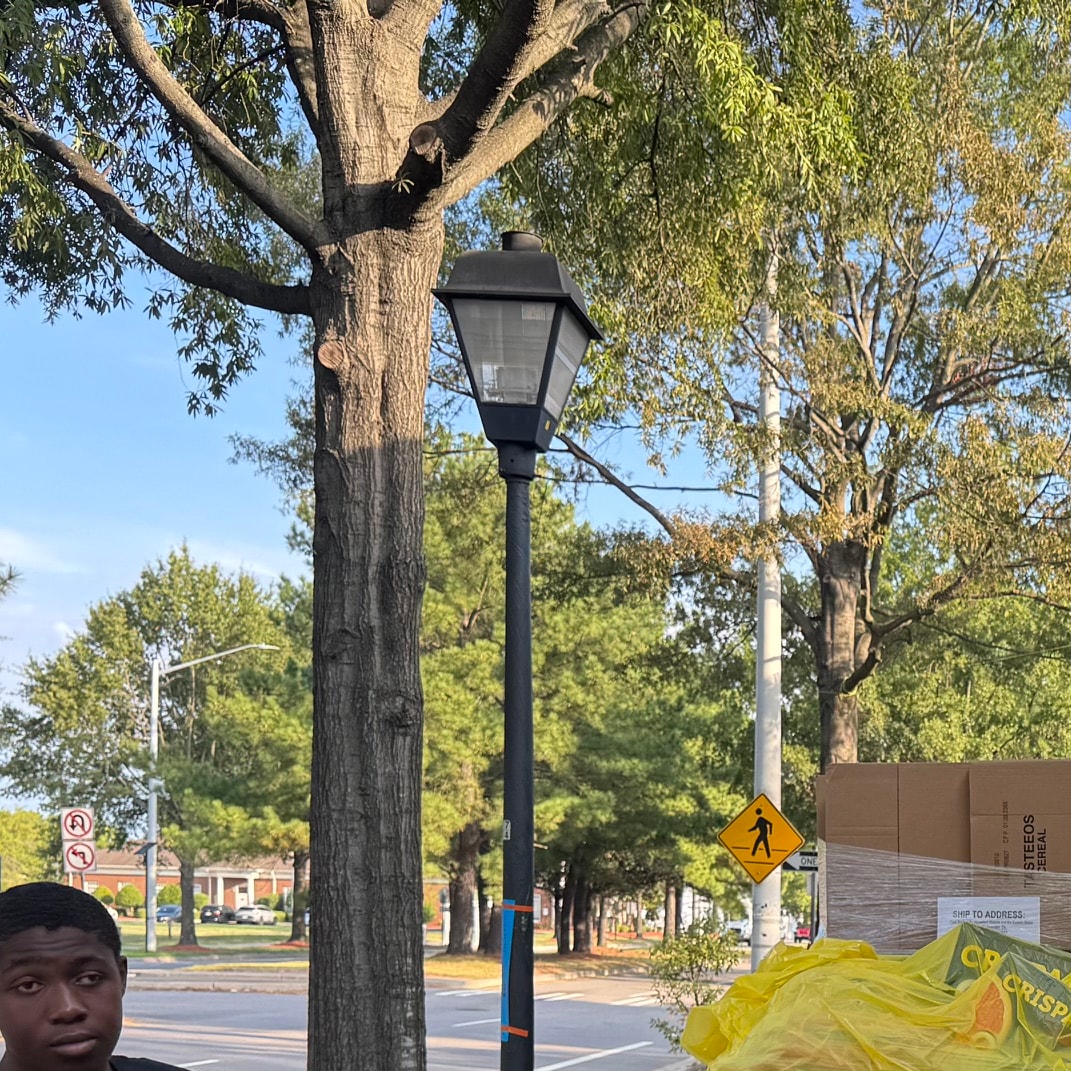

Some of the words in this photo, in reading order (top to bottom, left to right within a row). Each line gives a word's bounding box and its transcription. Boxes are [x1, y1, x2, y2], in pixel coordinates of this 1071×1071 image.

[800, 857, 818, 866] ONE
[953, 910, 971, 919] SHIP
[972, 910, 983, 919] TO
[984, 910, 1026, 919] ADDRESS:
